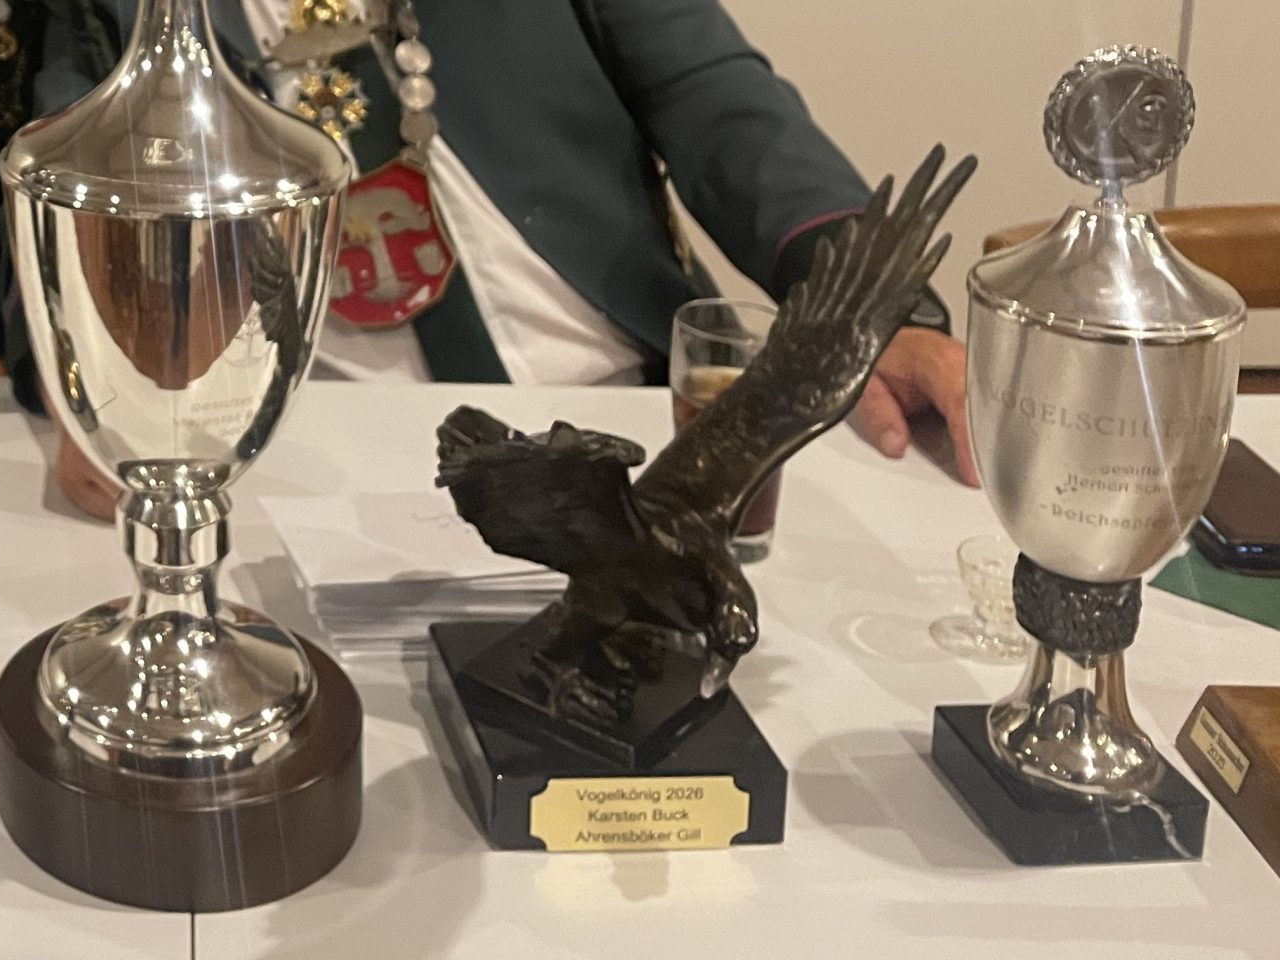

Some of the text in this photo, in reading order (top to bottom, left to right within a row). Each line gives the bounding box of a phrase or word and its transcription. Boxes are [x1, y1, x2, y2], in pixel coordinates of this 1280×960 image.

[576, 787, 704, 804] Vogelkönig 2026
[587, 809, 689, 822] Karsten Buck
[575, 830, 672, 843] Ahrensböker
